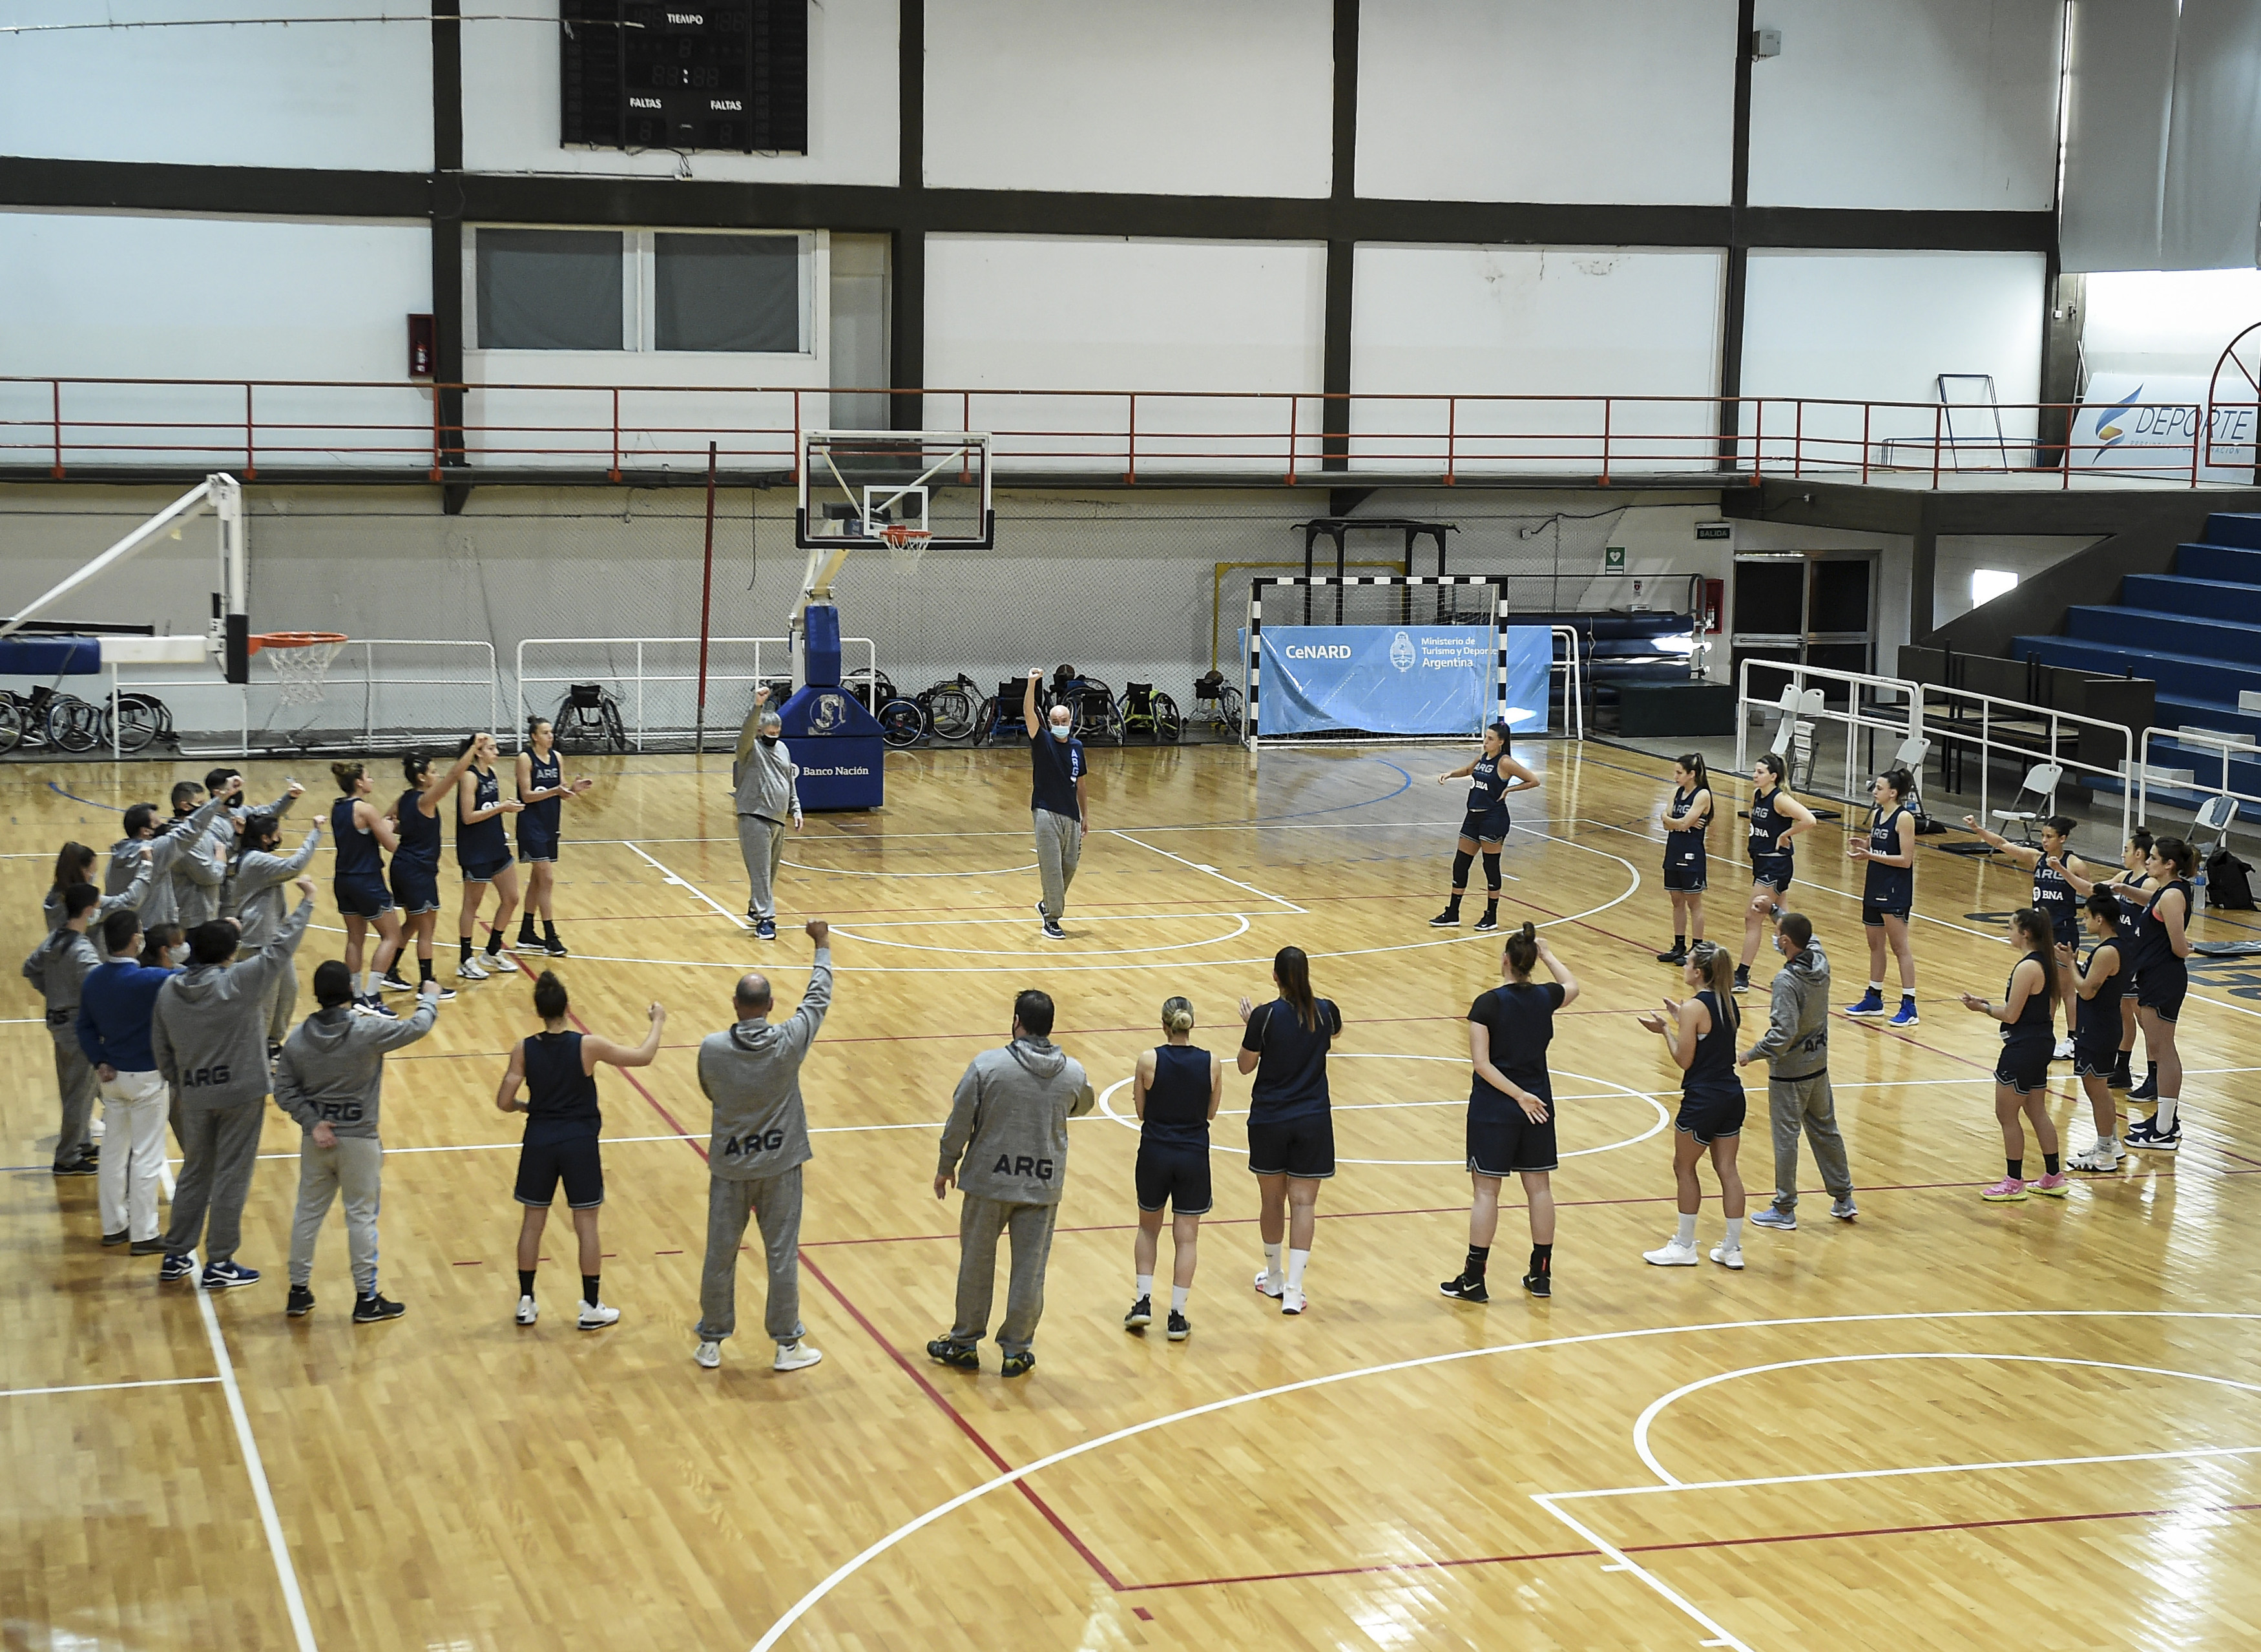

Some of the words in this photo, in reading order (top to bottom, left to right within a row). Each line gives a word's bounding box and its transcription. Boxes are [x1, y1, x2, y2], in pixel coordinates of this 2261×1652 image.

[667, 13, 703, 25] TIEMPO
[630, 98, 662, 109] FALTAS
[711, 100, 742, 110] FALTAS
[2135, 407, 2253, 440] DEPORTE
[1421, 637, 1464, 645] Ministerio
[1465, 637, 1475, 645] de
[1286, 645, 1351, 659] CeNARD
[1456, 648, 1462, 657] y
[1463, 647, 1498, 656] Depore
[1422, 657, 1474, 670] Argentina
[1071, 749, 1079, 778] ARG
[1474, 762, 1495, 773] ARG
[803, 767, 833, 776] Banco
[835, 766, 869, 775] Nación
[2042, 891, 2064, 901] BNA
[2120, 914, 2132, 925] NA
[183, 1065, 231, 1088] ARG
[725, 1129, 784, 1156] ARG
[993, 1154, 1053, 1181] ARG
